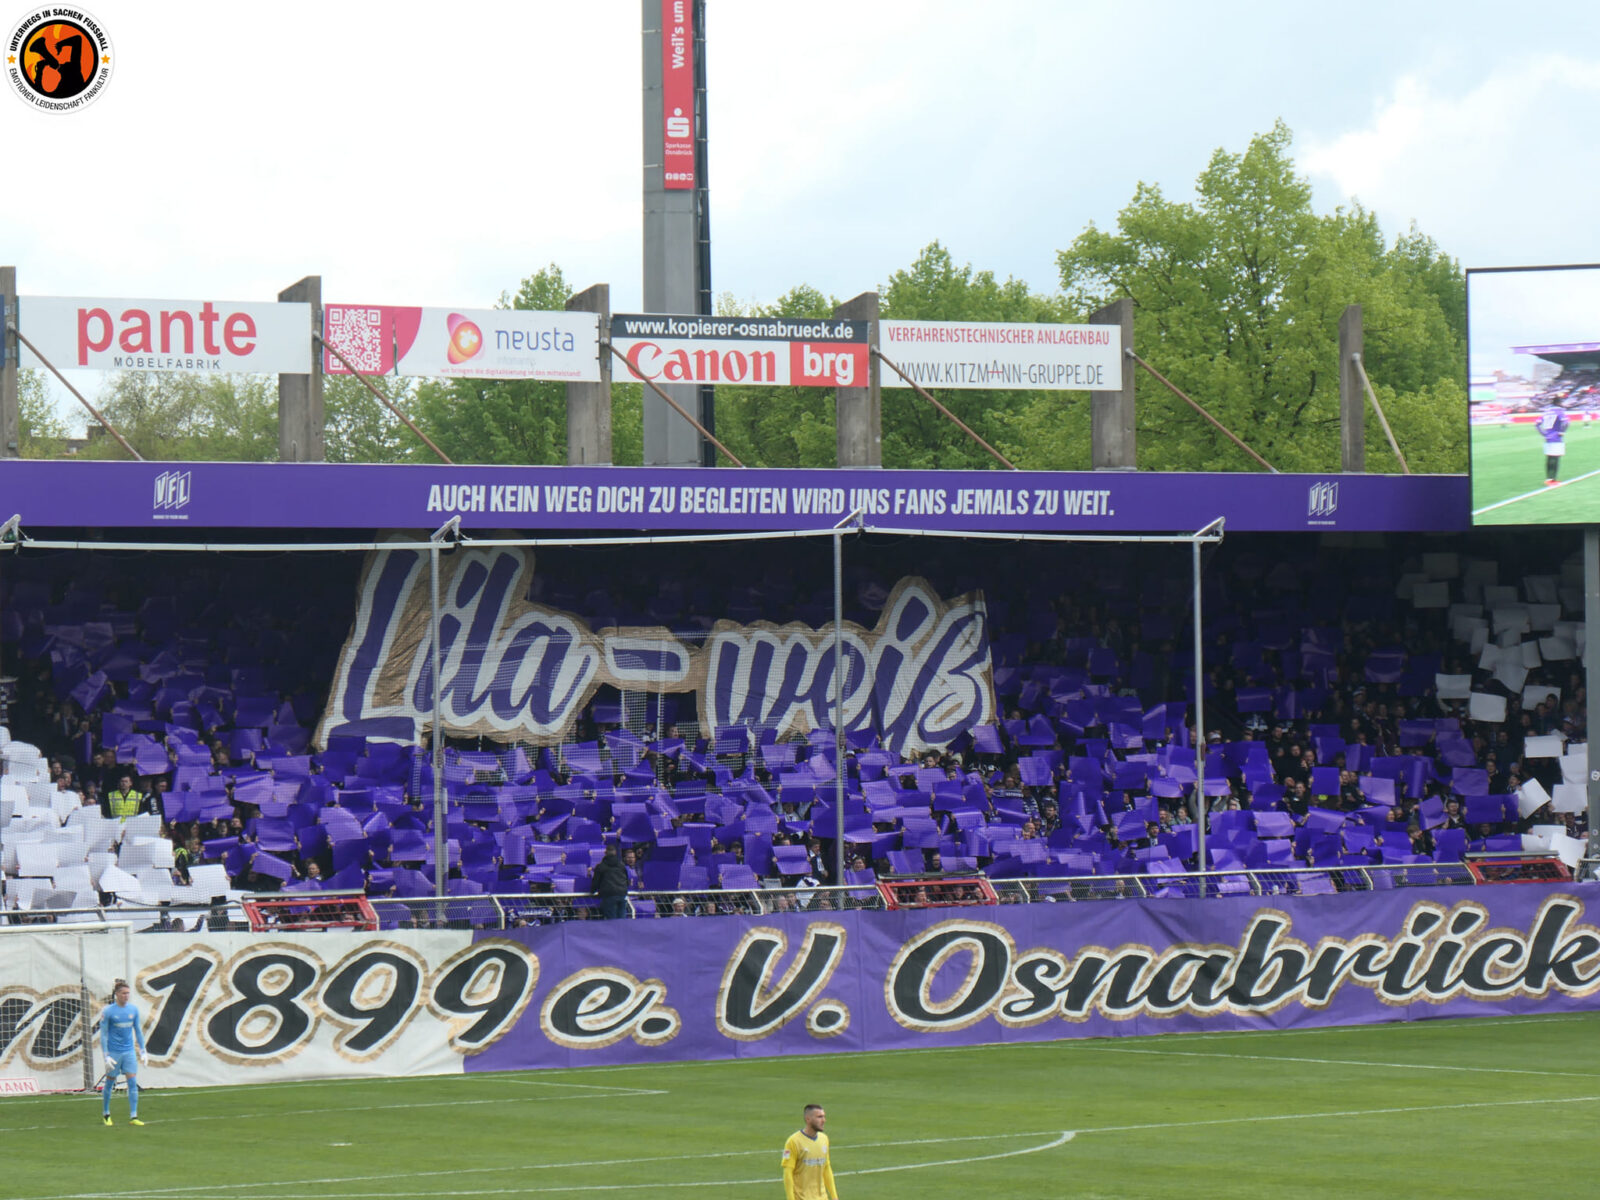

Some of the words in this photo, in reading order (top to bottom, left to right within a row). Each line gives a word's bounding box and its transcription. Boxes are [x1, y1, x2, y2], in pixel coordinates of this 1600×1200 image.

[674, 1, 684, 23] um
[671, 26, 685, 69] Weil's
[78, 302, 257, 366] pante
[495, 327, 575, 352] neusta
[625, 318, 854, 340] www.kopierer-osnabrueck.de
[888, 327, 1034, 344] VERFAHRENSTECHNISCHER
[1037, 330, 1110, 345] ANLAGENBAU
[114, 356, 221, 369] MÖBELFABRIK
[626, 342, 776, 382] Canon
[803, 344, 854, 385] brg
[897, 360, 1104, 385] WWW.KITZMANN-GRUPPE.DE
[427, 484, 485, 512] AUCH
[490, 485, 539, 512] KEIN
[544, 485, 592, 513] WEG
[597, 486, 644, 513] DICH
[648, 486, 676, 513] ZU
[680, 487, 787, 514] BEGLEITEN
[792, 487, 845, 514] WIRD
[850, 488, 889, 514] UNS
[894, 488, 947, 515] FANS
[951, 489, 1029, 515] JEMALS
[1033, 489, 1058, 515] ZU
[1063, 490, 1115, 516] WEIT.
[139, 943, 536, 1063] 1899
[542, 969, 679, 1047] e.
[718, 924, 848, 1038] V.
[887, 896, 1600, 1029] Osnabrück
[0, 1081, 34, 1092] ANN
